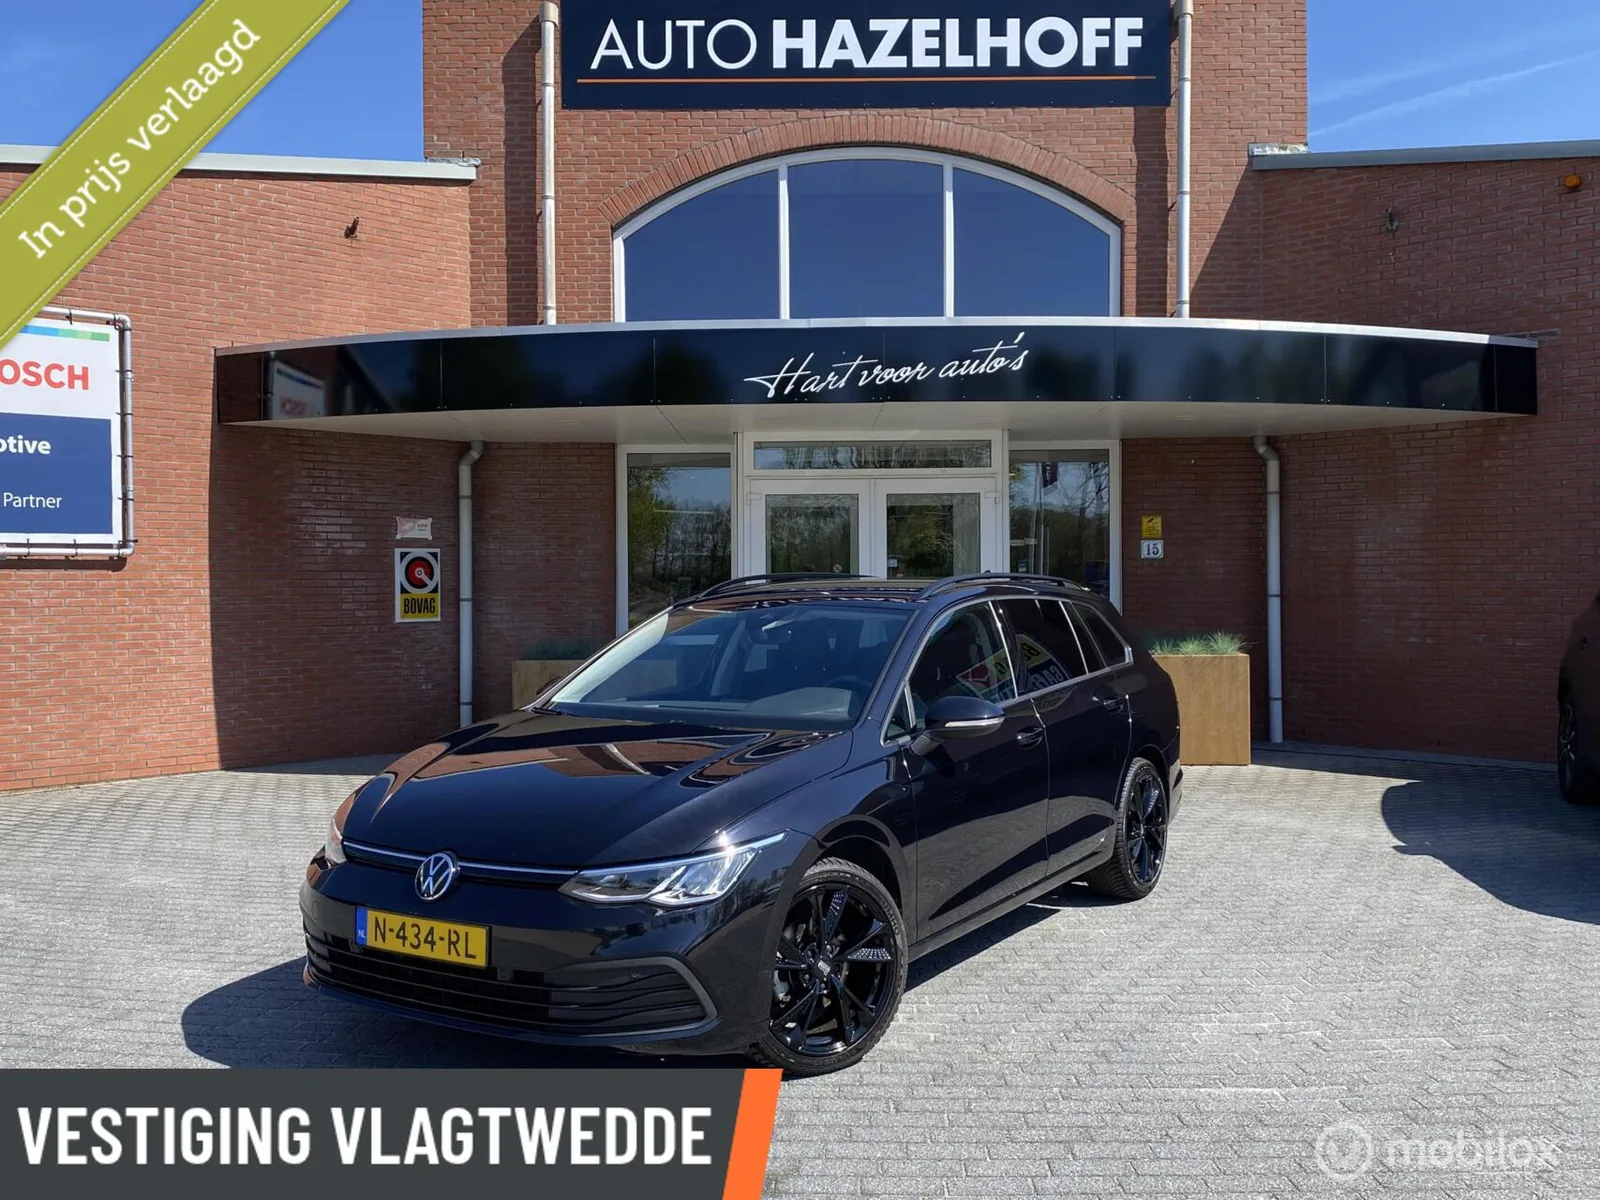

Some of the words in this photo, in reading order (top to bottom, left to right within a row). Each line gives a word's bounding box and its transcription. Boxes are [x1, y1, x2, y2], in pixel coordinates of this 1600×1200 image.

[590, 18, 757, 71] AUTO
[773, 16, 1143, 69] HAZELHOFF
[0, 358, 90, 391] OSCH
[743, 352, 879, 398] Hart
[858, 361, 936, 387] voor
[3, 492, 62, 509] Partner
[1146, 542, 1160, 556] 15
[404, 598, 435, 614] BOVAG
[357, 929, 367, 939] NL
[374, 916, 476, 958] N-434-RL
